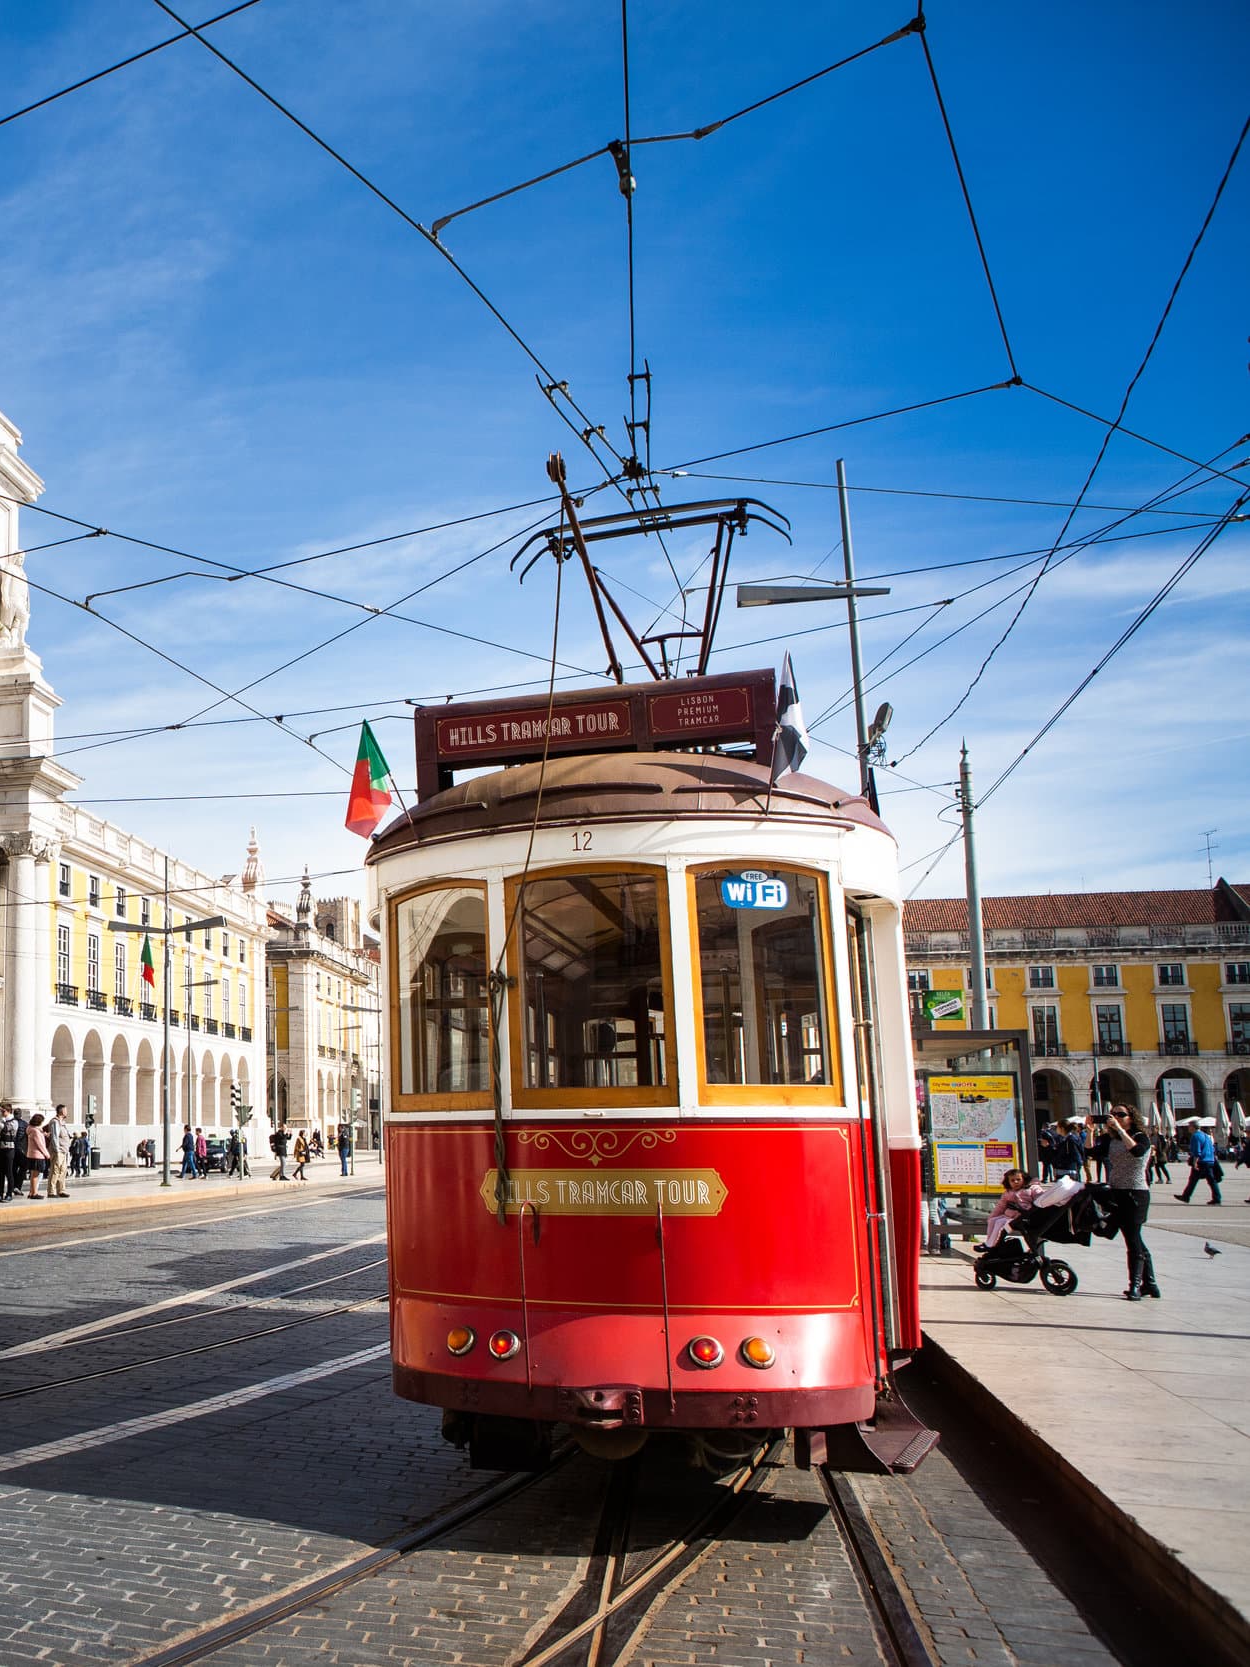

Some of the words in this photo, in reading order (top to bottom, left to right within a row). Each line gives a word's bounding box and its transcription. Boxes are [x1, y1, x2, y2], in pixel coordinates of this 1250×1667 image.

[680, 695, 714, 706] LISBON
[677, 705, 719, 716] PREMIUM
[678, 715, 720, 727] TRAMCAR
[449, 724, 498, 747] HILLS
[501, 717, 572, 742] TRAMCAR
[575, 712, 620, 734] TOUR
[572, 831, 593, 851] 12
[745, 873, 763, 881] FREE
[555, 1180, 648, 1205] TRAMCAR
[653, 1180, 711, 1205] TOUR
